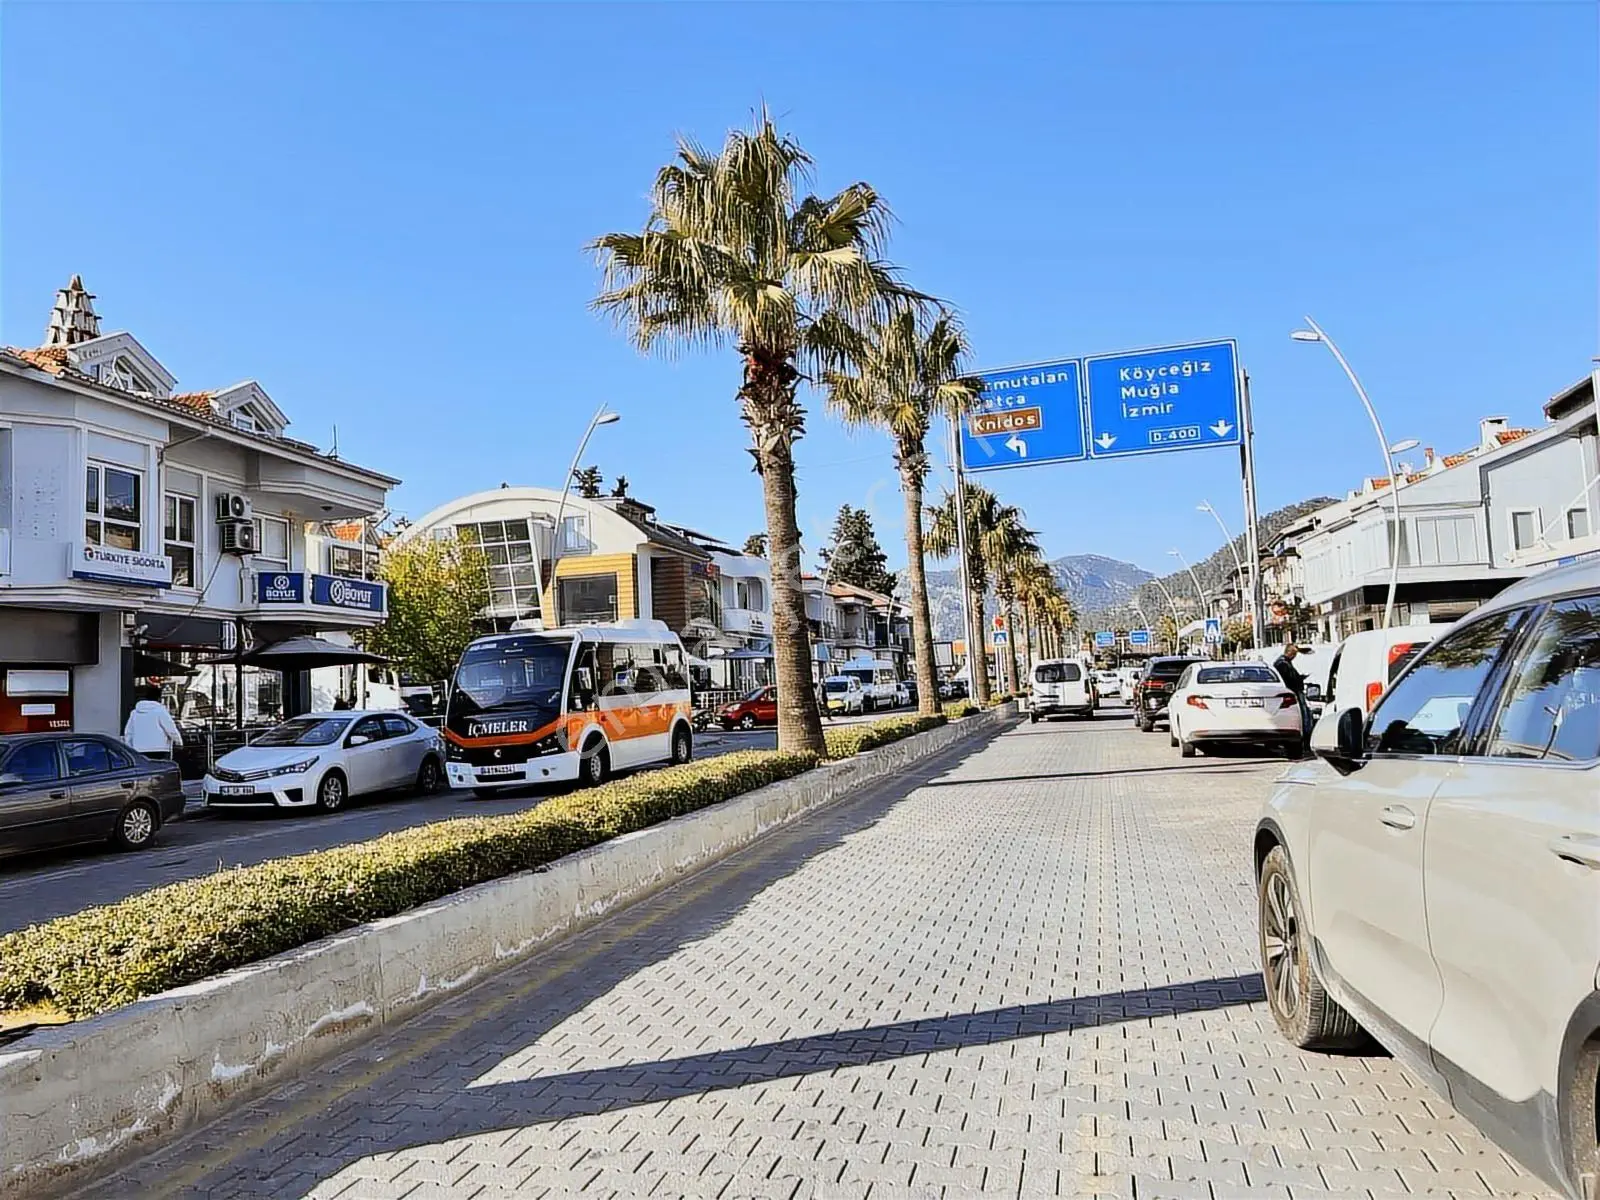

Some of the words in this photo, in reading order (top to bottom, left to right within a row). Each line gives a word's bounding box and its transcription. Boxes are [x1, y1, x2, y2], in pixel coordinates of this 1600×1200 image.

[1120, 361, 1211, 381] Köyceğiz
[984, 372, 1068, 391] rmutalan
[1121, 382, 1179, 399] Muğla
[1122, 402, 1173, 418] İzmir
[973, 415, 1036, 431] Knidos
[1153, 428, 1197, 442] D.400
